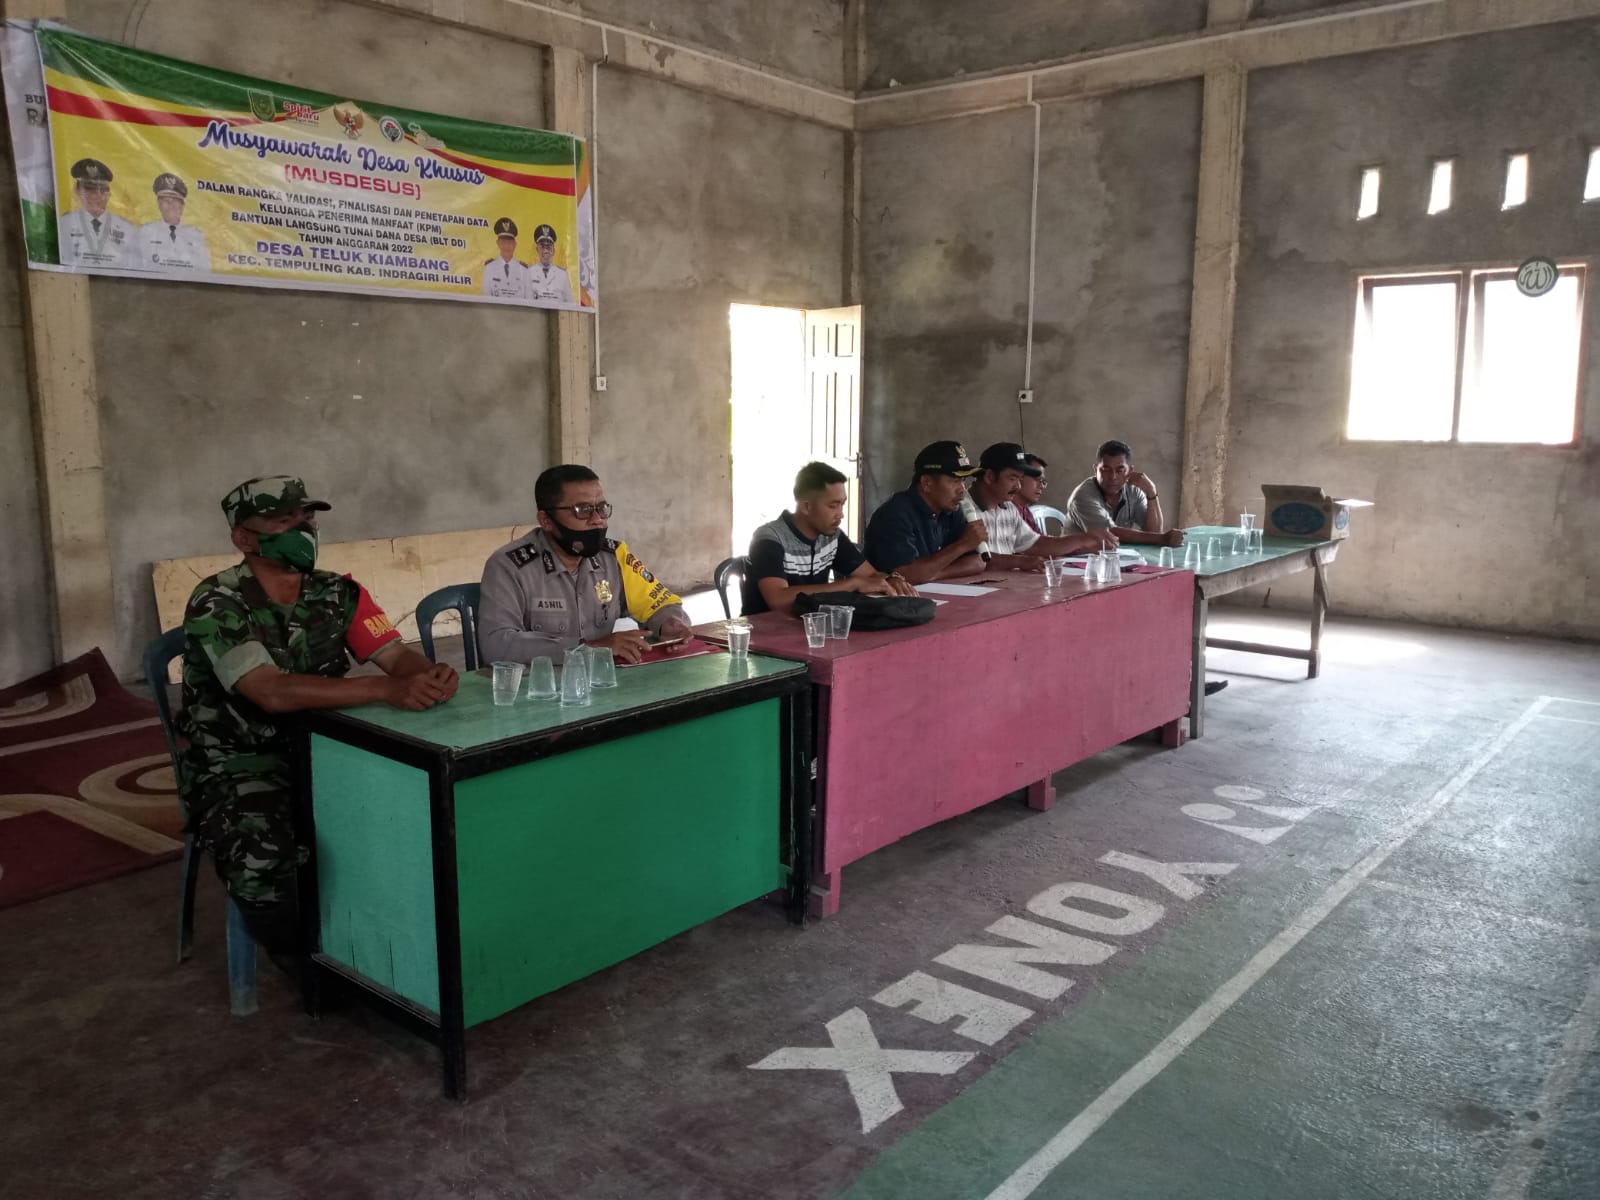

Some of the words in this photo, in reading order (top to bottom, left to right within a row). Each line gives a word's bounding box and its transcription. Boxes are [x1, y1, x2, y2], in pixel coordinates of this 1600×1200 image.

[199, 122, 351, 164] Musyawarah
[357, 146, 409, 172] Desa
[415, 156, 485, 185] Khusus
[284, 164, 421, 200] (MUSDESUS)
[197, 180, 235, 195] DALAM
[238, 187, 282, 201] RANGKA
[286, 193, 336, 209] VALIDASI,
[338, 200, 391, 215] FINALISASI
[393, 207, 412, 218] DAN
[415, 210, 465, 225] PENETAPAN
[467, 218, 489, 227] DATA
[259, 202, 315, 218] KELUARGA
[318, 210, 368, 225] PENERIMA
[371, 217, 414, 229] MANFAAT
[416, 223, 442, 235] (KPM)
[231, 212, 282, 226] BANTUAN
[285, 219, 341, 233] LANGSUNG
[344, 226, 373, 237] TUNAI
[376, 230, 401, 240] DANA
[404, 233, 428, 243] DESA
[430, 237, 448, 246] (BLT
[451, 239, 466, 248] DD)
[299, 233, 333, 244] TAHUN
[336, 238, 389, 251] ANGGARAN
[391, 243, 413, 254] 2022
[228, 254, 261, 266] KEC.
[265, 257, 342, 274] TEMPULING
[347, 265, 375, 276] KAB.
[379, 269, 439, 282] INDRAGIRI
[442, 276, 472, 285] HILIR
[256, 241, 304, 257] DESA
[309, 247, 362, 263] TELUK
[368, 253, 450, 271] KIAMBANG
[746, 850, 1241, 1135] YONEX
